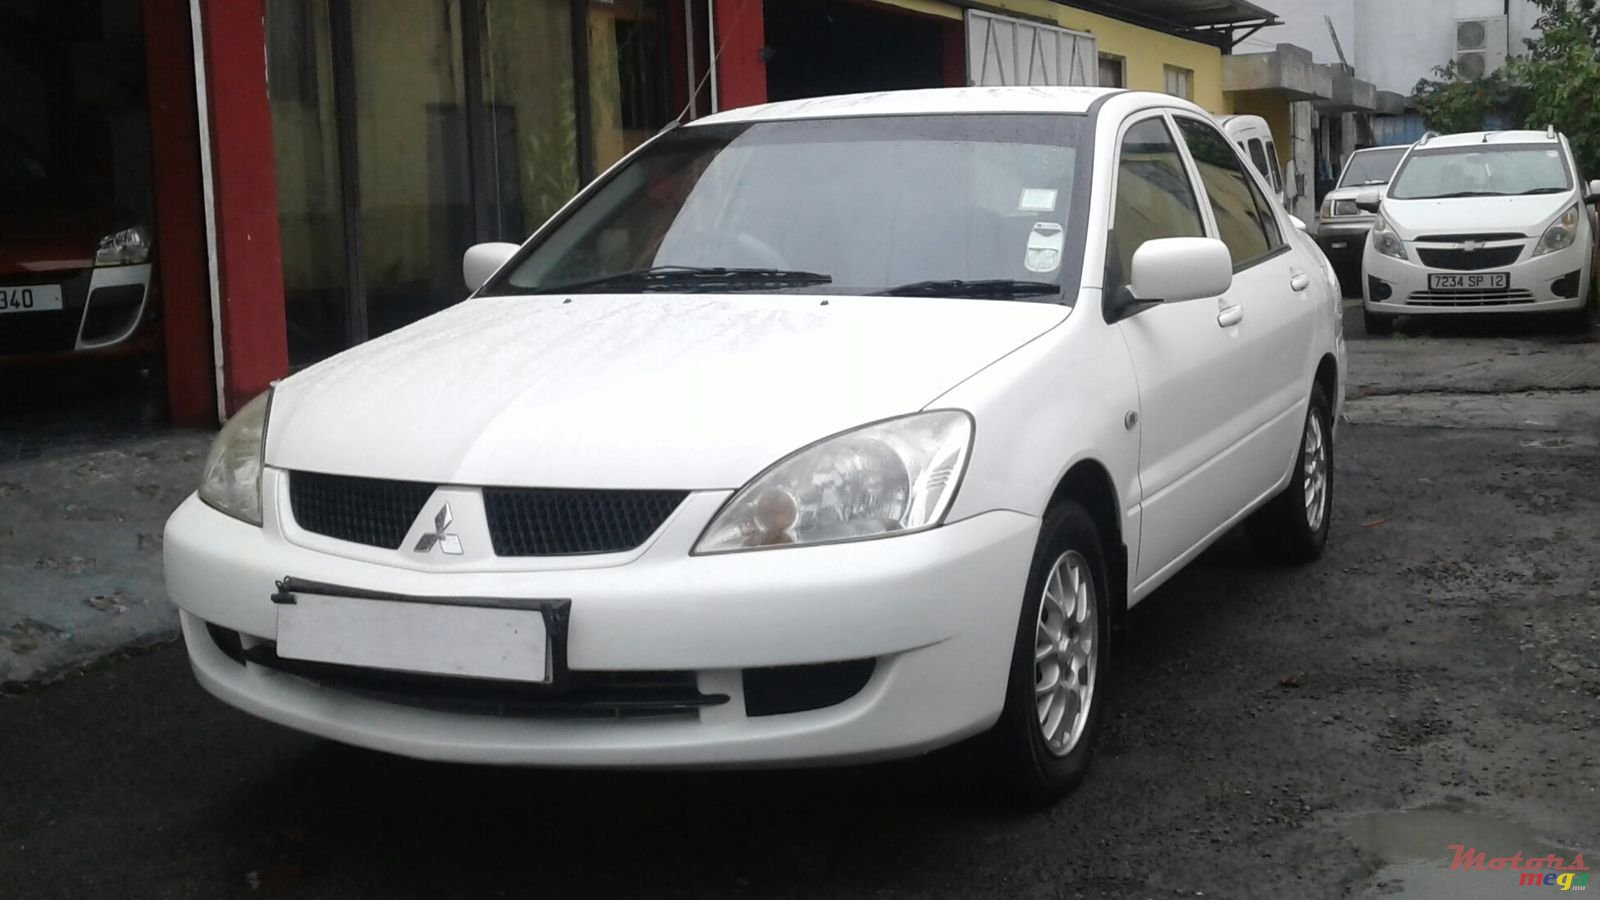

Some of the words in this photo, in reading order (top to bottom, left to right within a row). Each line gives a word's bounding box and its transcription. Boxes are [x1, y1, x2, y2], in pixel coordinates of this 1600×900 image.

[1435, 276, 1463, 287] 7234
[1468, 276, 1483, 287] SP
[1490, 275, 1504, 287] 12
